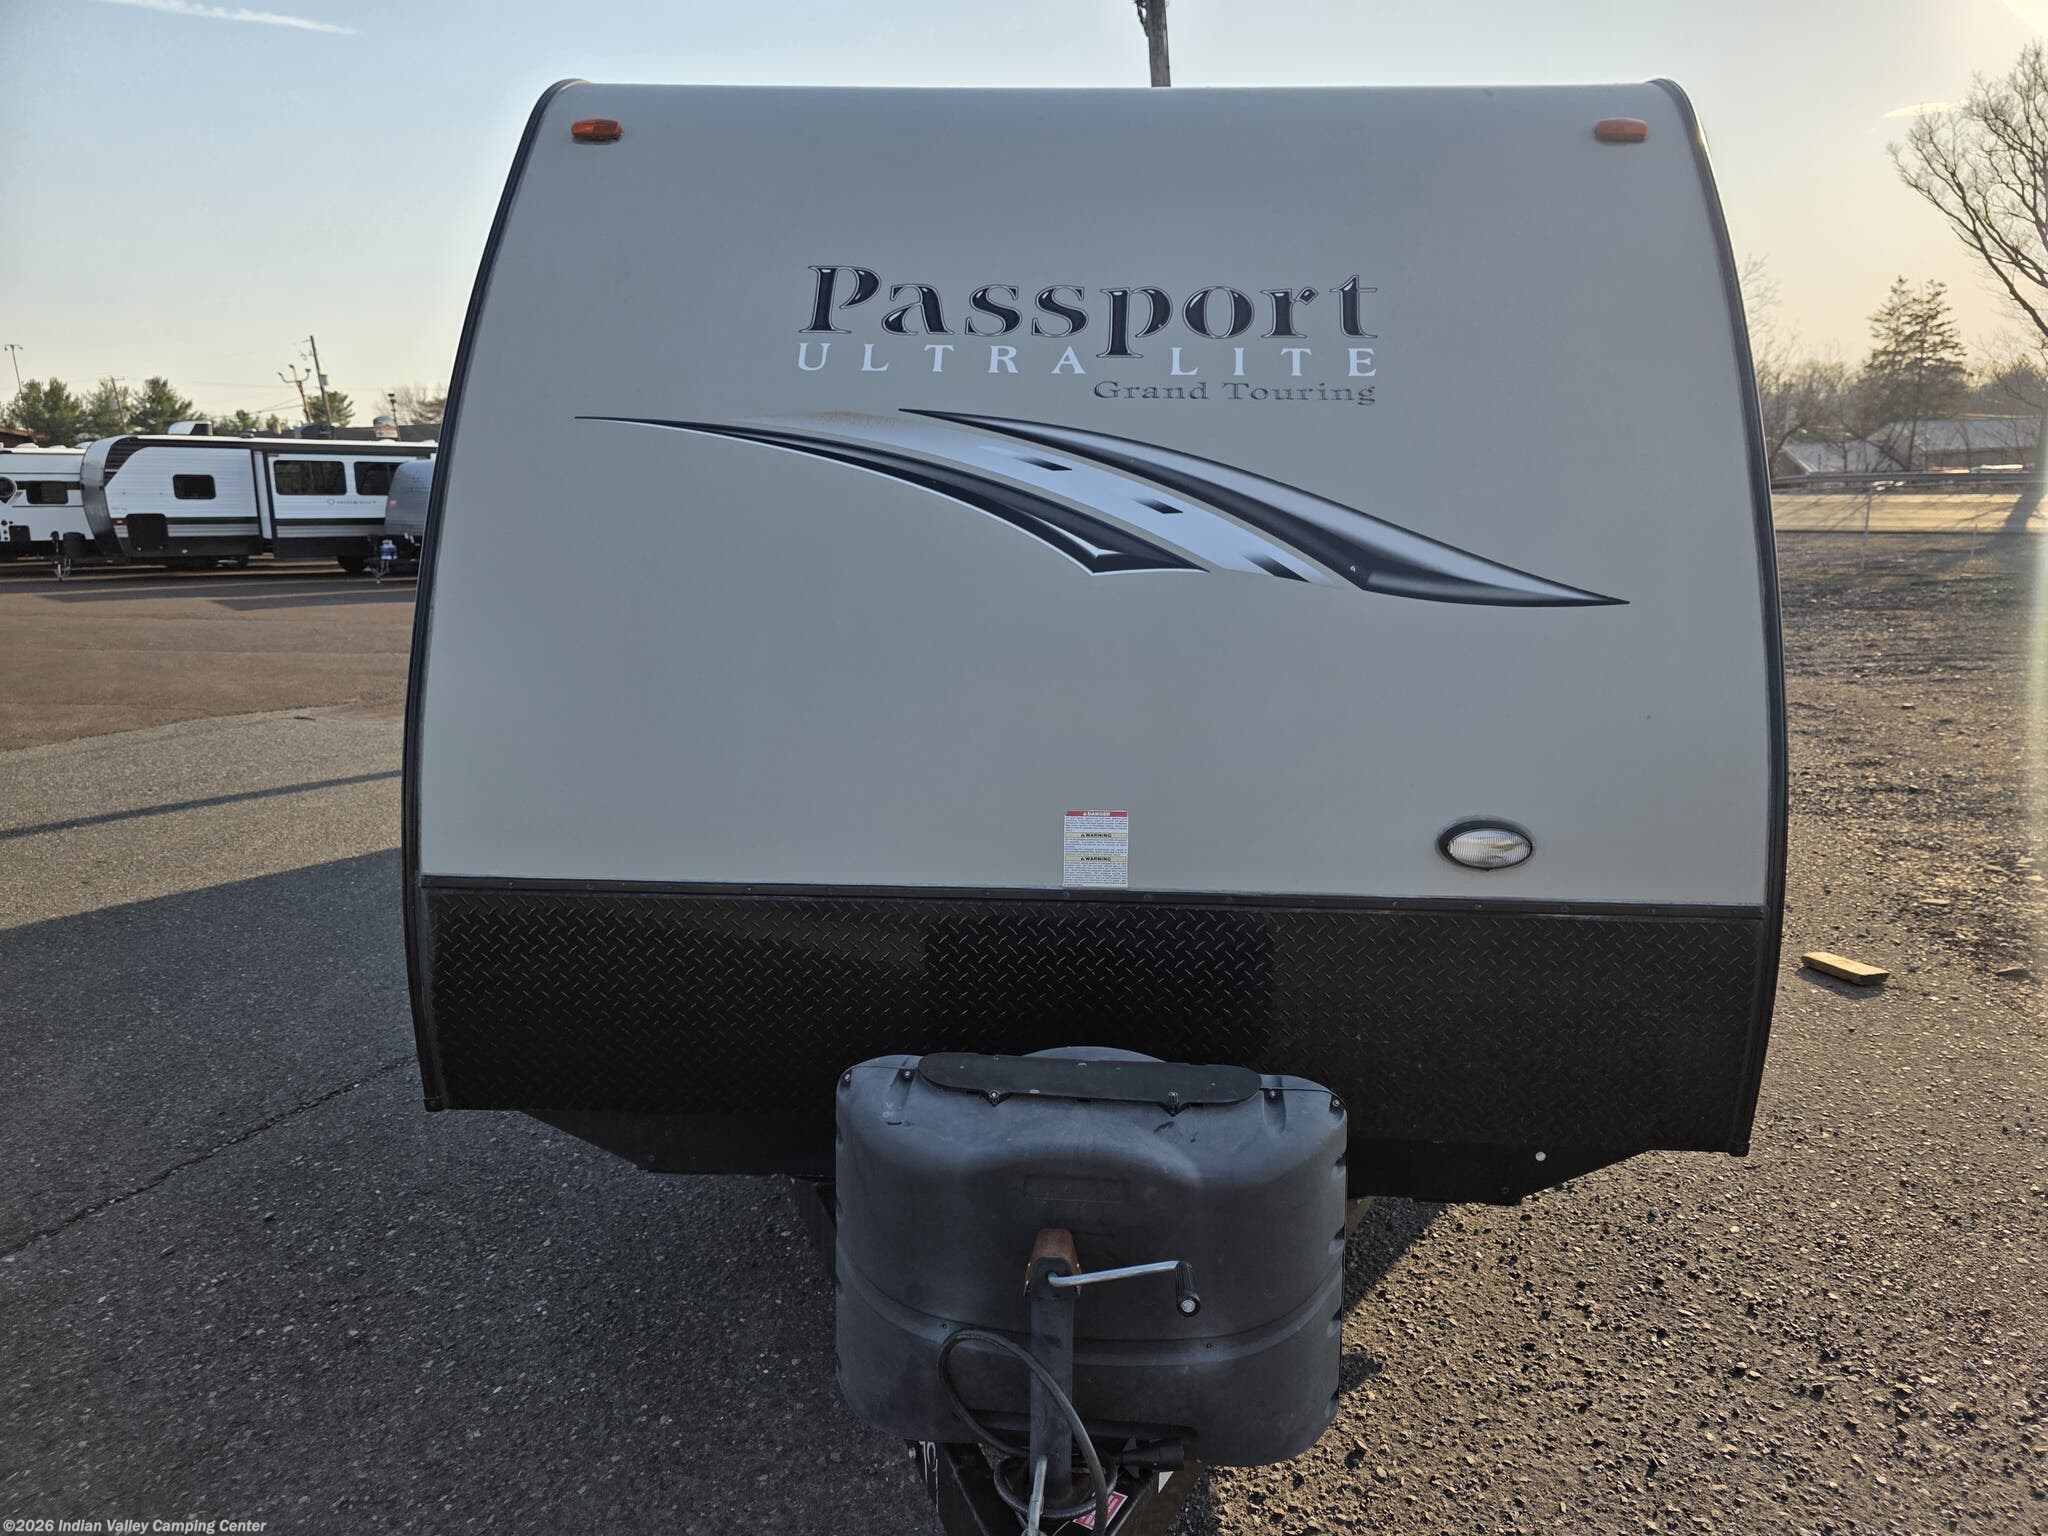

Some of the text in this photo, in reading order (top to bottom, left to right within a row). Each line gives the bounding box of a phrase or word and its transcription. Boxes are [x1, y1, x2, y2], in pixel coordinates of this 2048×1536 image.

[798, 264, 1378, 358] Passport
[798, 342, 1377, 377] ULTRA LITE
[1094, 380, 1376, 407] Grand Touring
